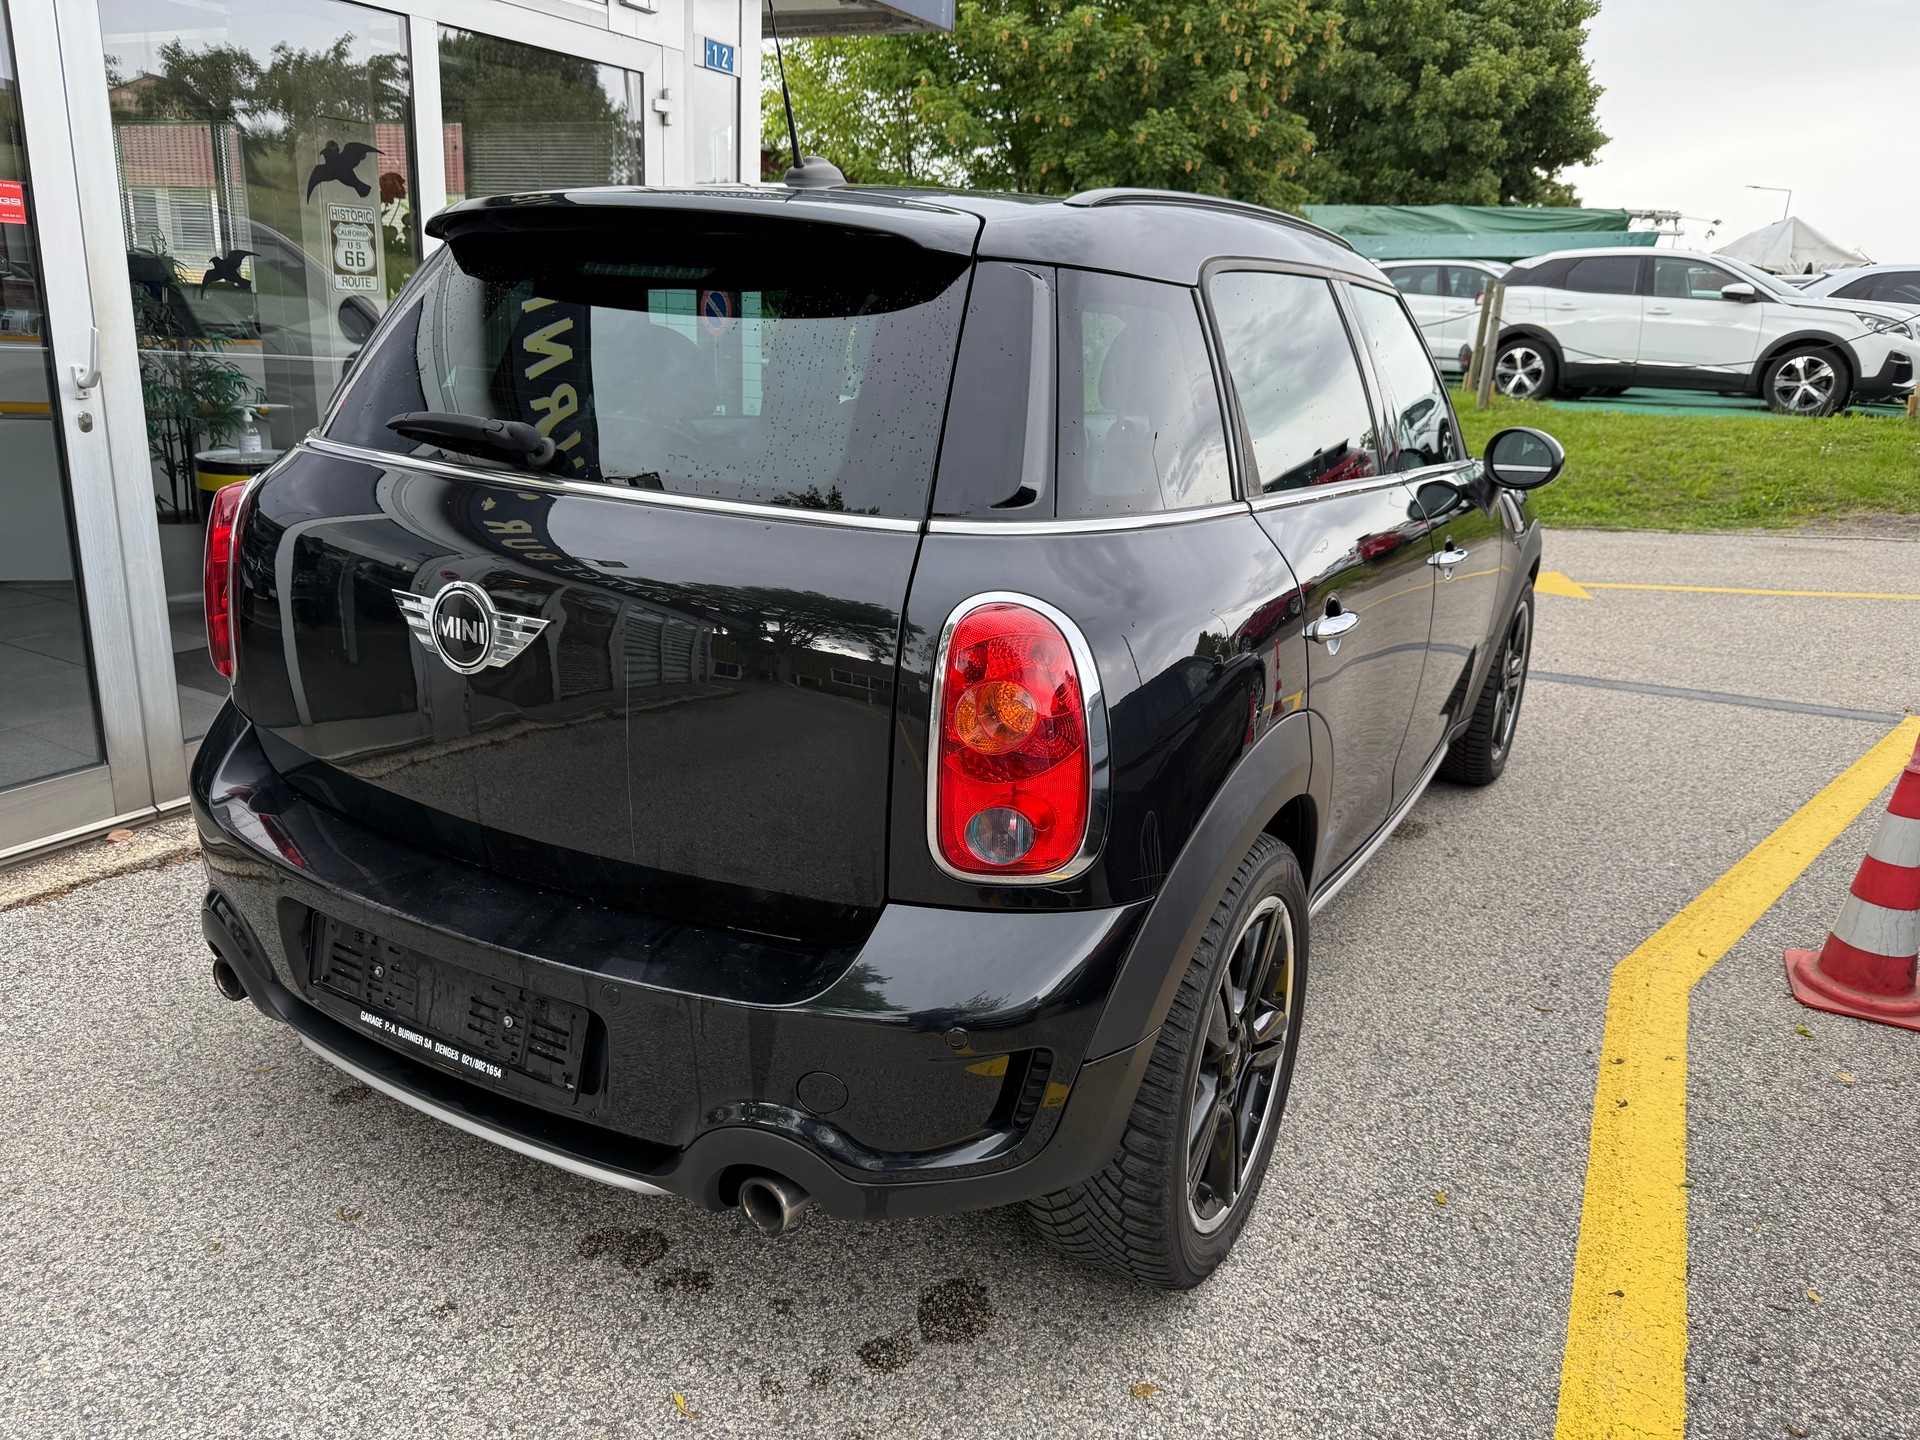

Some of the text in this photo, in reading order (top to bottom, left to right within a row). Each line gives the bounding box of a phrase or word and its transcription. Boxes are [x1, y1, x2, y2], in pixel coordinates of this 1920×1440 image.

[712, 44, 729, 69] 12
[331, 208, 373, 222] HISTORIC
[337, 229, 369, 238] CALIFORNIA
[345, 250, 366, 267] 66
[342, 276, 372, 288] ROUTE
[437, 613, 485, 645] MINI
[360, 1010, 383, 1029] GARAGE
[397, 1026, 424, 1046] BURNIER
[424, 1037, 433, 1050] SA
[435, 1042, 459, 1061] DENGES
